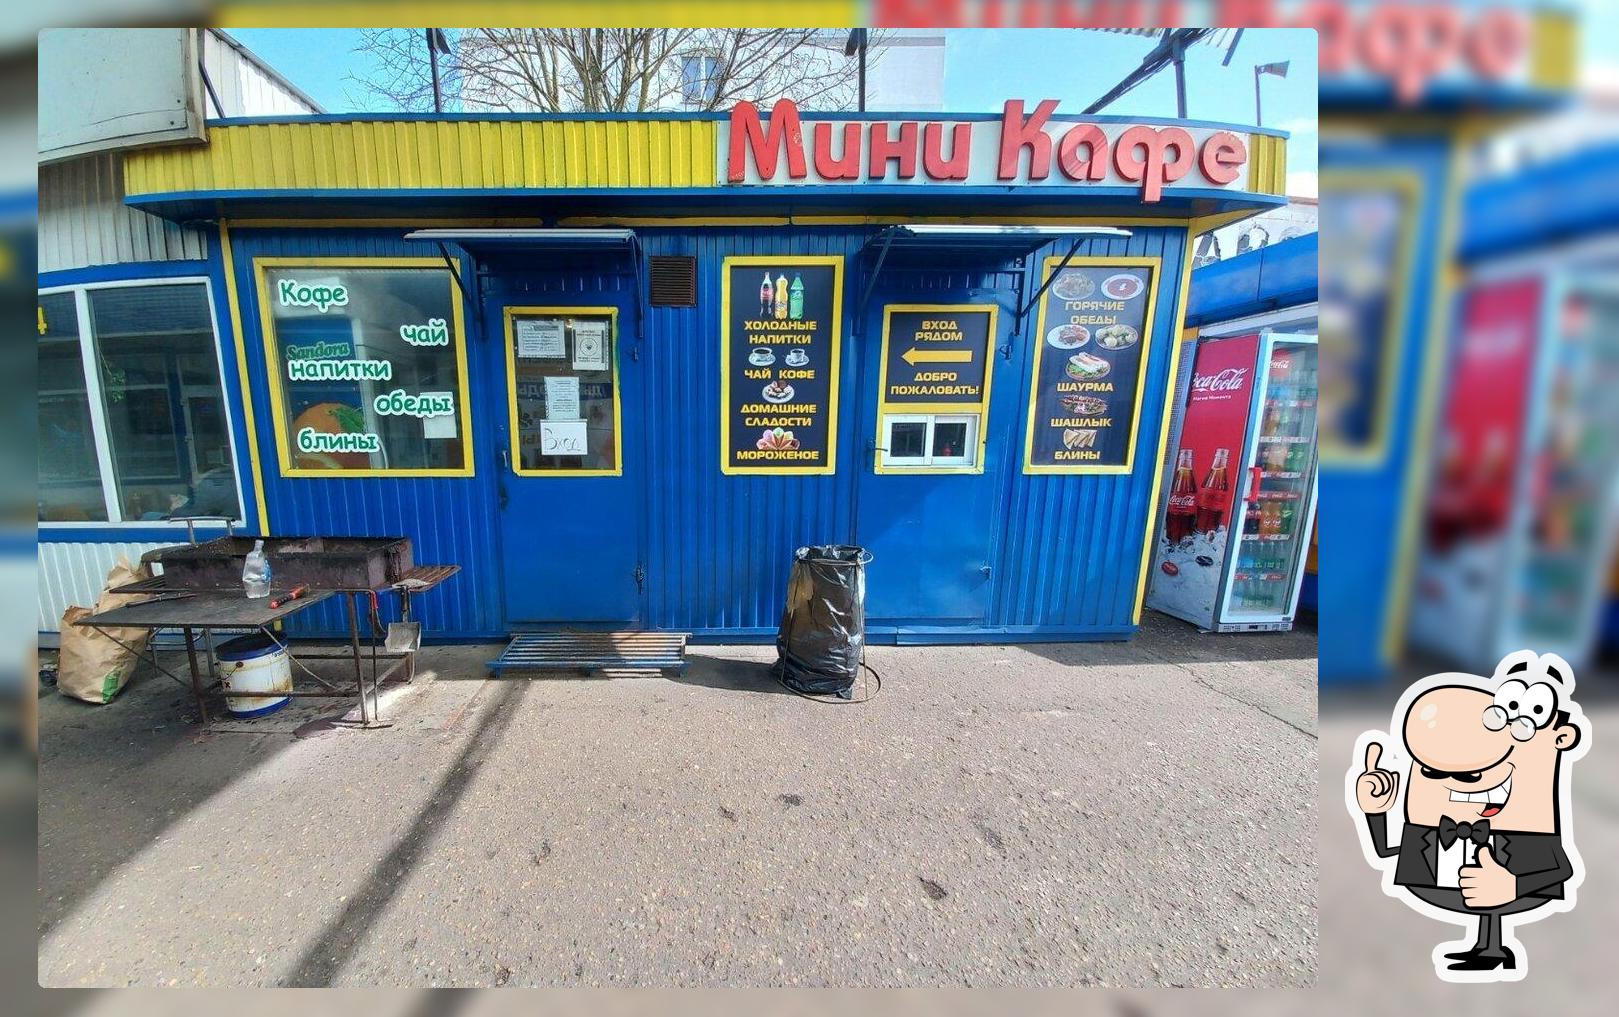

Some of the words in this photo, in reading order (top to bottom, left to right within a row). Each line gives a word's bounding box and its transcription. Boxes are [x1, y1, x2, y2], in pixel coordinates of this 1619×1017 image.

[728, 98, 972, 183] Мини
[998, 98, 1248, 204] Кафе
[279, 280, 347, 311] Кофе
[1065, 301, 1125, 311] ГОРЯЧИЕ
[921, 320, 958, 330] ВХОД
[1070, 315, 1117, 325] ОБЕДЫ
[744, 321, 817, 331] ХОЛОДНЫЕ
[401, 319, 447, 345] чай
[915, 332, 963, 341] РЯДОМ
[749, 335, 812, 344] НАПИТКИ
[287, 341, 349, 361] Sandora
[289, 360, 391, 380] напитки
[744, 368, 772, 379] ЧАЙ
[779, 370, 815, 379] КОФЕ
[914, 372, 958, 382] ДОБРО
[890, 385, 980, 395] ПОЖАЛОВАТЬ!
[1057, 383, 1114, 392] ШАУРМА
[375, 390, 453, 415] обеды
[740, 404, 817, 414] ДОМАШНИЕ
[745, 417, 812, 427] СЛАДОСТИ
[1050, 418, 1112, 427] ШАШЛЫК
[298, 428, 379, 452] блины
[736, 450, 820, 460] МОРОЖЕНОЕ
[1054, 450, 1101, 460] БЛИНЫ
